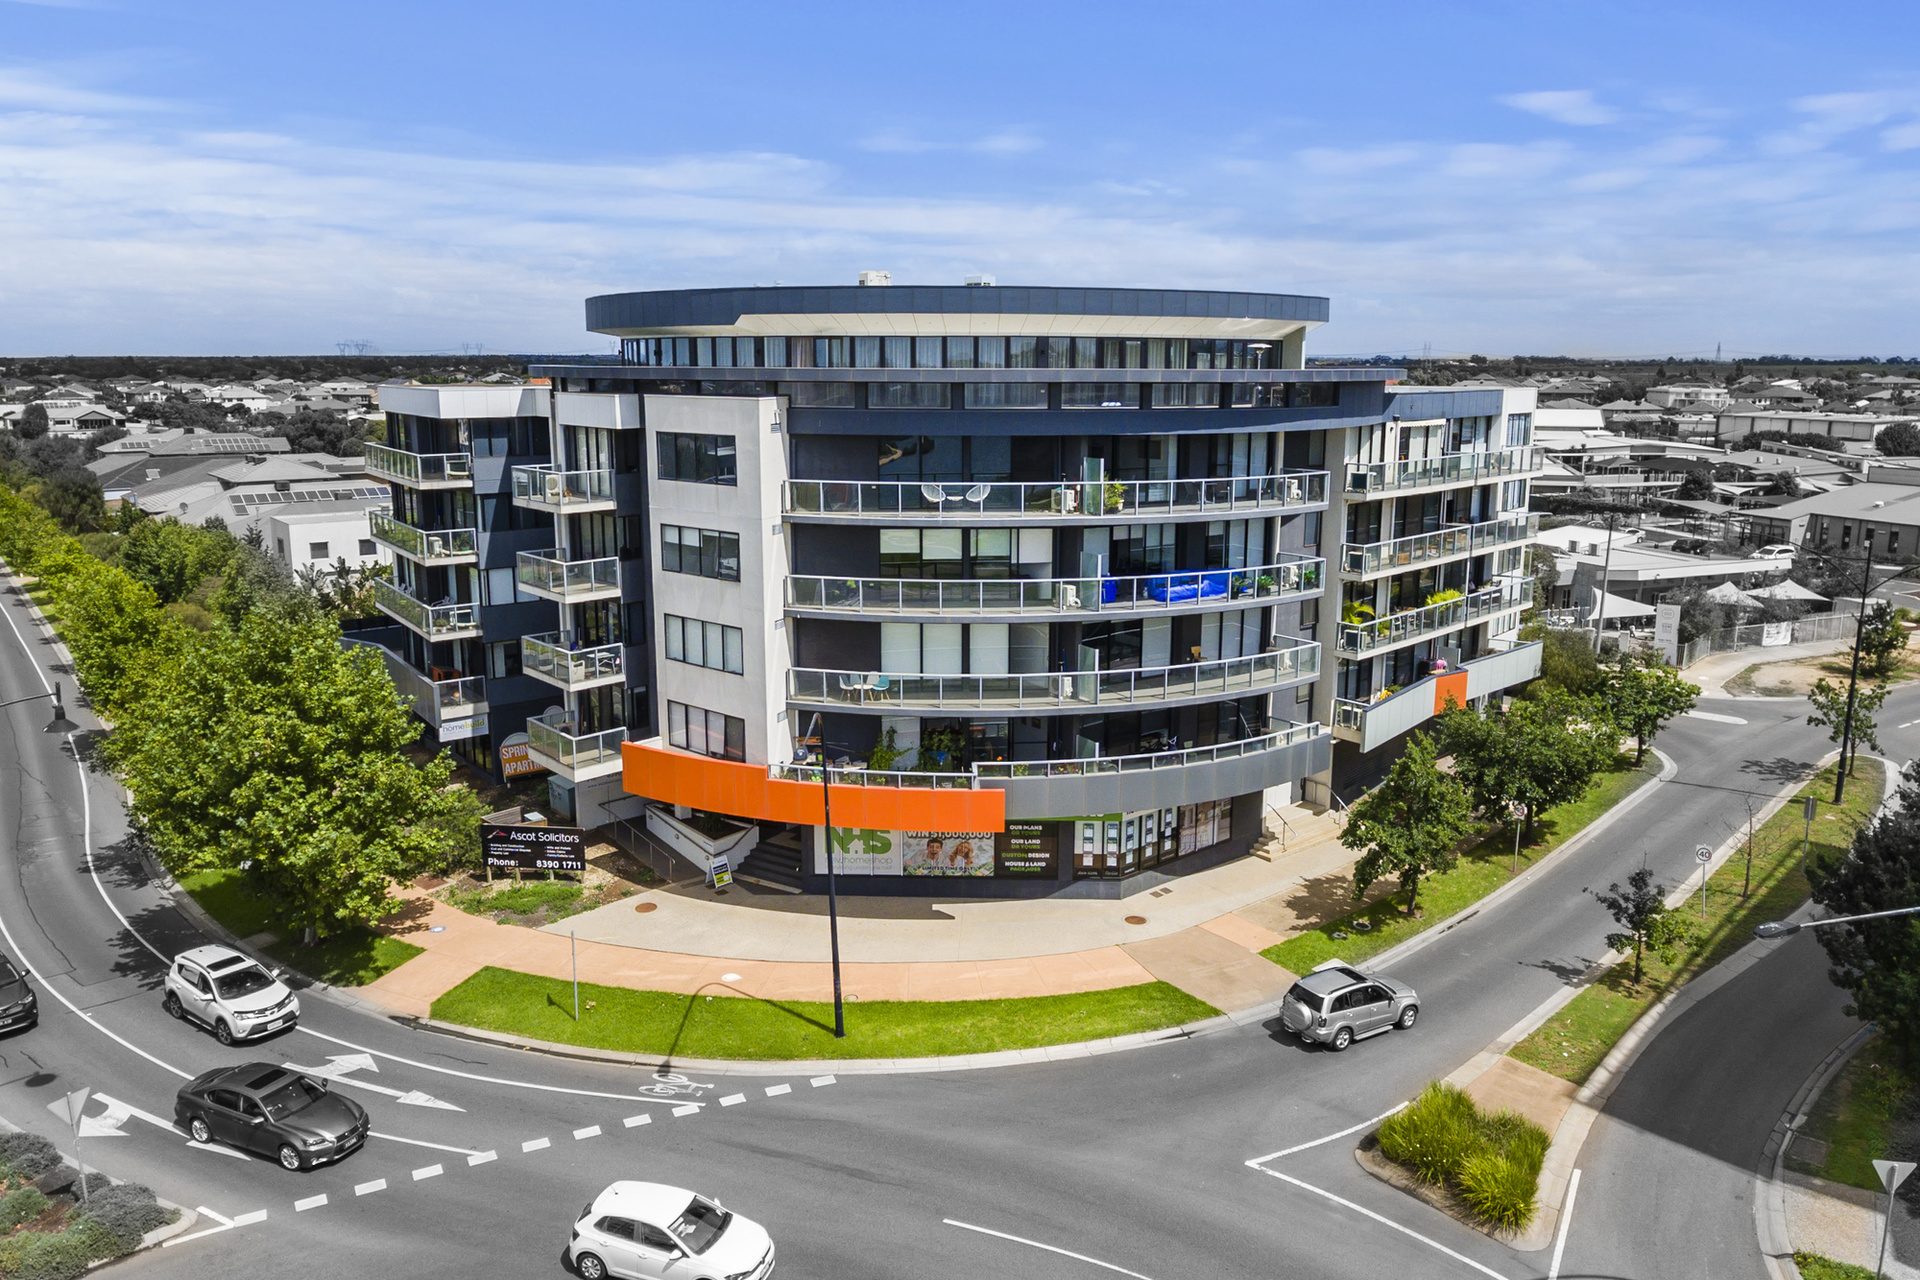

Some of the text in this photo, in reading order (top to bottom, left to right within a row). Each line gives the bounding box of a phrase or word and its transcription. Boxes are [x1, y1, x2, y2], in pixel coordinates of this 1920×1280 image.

[443, 719, 485, 732] homebuild
[510, 831, 580, 843] Ascot Solicitors
[825, 827, 892, 854] NHS
[488, 857, 581, 869] Phone: 8390 1711
